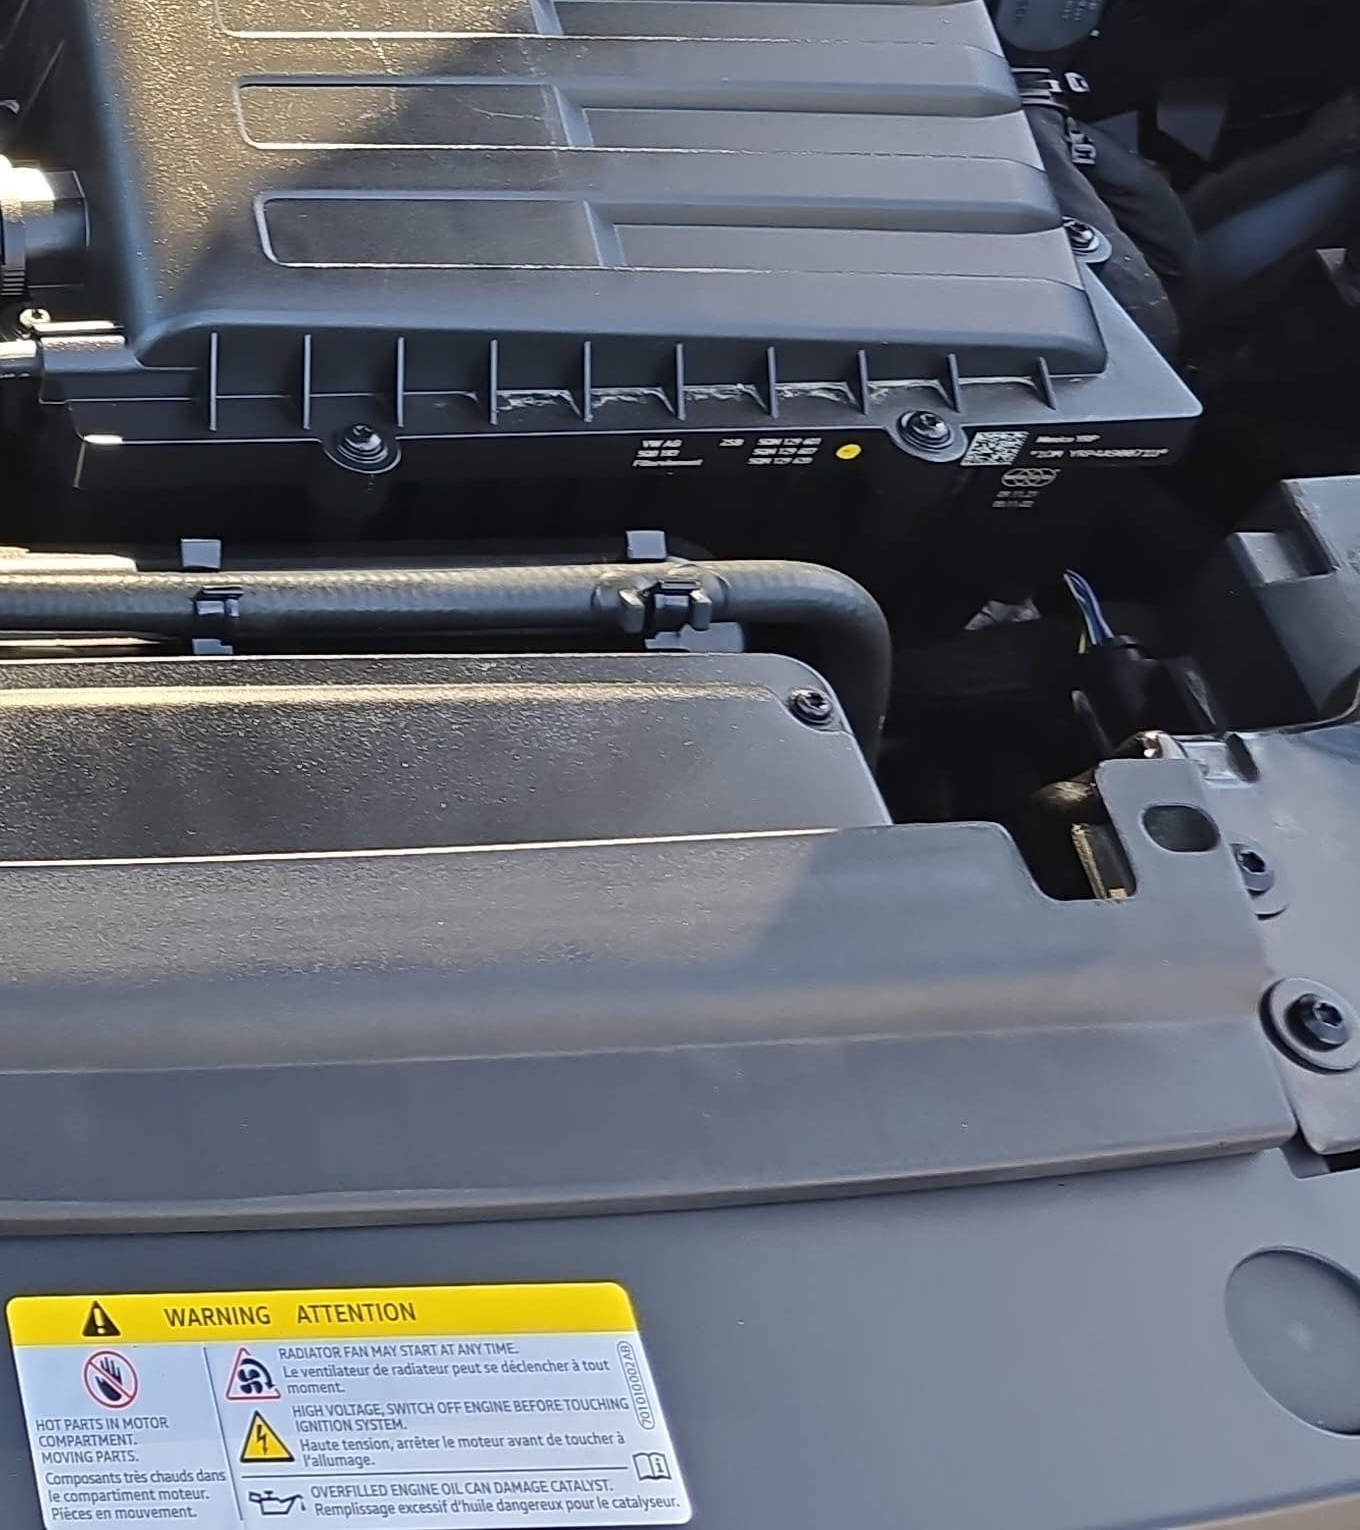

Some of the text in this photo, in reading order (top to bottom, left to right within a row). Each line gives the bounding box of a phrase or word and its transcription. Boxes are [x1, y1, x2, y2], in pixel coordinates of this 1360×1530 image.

[163, 1302, 417, 1328] WARNING ATTENTION
[279, 1342, 520, 1360] RADIATOR FAN MAY START AT ANY TIME.
[282, 1358, 611, 1379] Le ventilateur de radiateur peut se déclencher à tout
[287, 1381, 346, 1395] moment.
[292, 1397, 630, 1418] HIGH VOLTAGE, SWITCH OFF ENGINE BEFORE TOUCHING
[36, 1416, 169, 1432] HOT PARTS IN MOTOR
[296, 1418, 408, 1433] IGNITION SYSTEM.
[38, 1433, 138, 1448] COMPARTMENT.
[299, 1431, 626, 1452] Haute tension, arrêter le moteur avant de toucher à
[41, 1449, 140, 1464] MOVING PARTS.
[303, 1454, 376, 1469] l'allumage.
[45, 1468, 227, 1488] Composants très chauds dans
[48, 1487, 210, 1505] le compartiment moteur.
[310, 1479, 614, 1499] OVERFILLED ENGINE OIL CAN DAMAGE CATALYST.
[51, 1505, 197, 1521] Pièces en mouvement.
[314, 1495, 681, 1519] Remplissage excessif d'huile dangereux pour le catalyseur.
